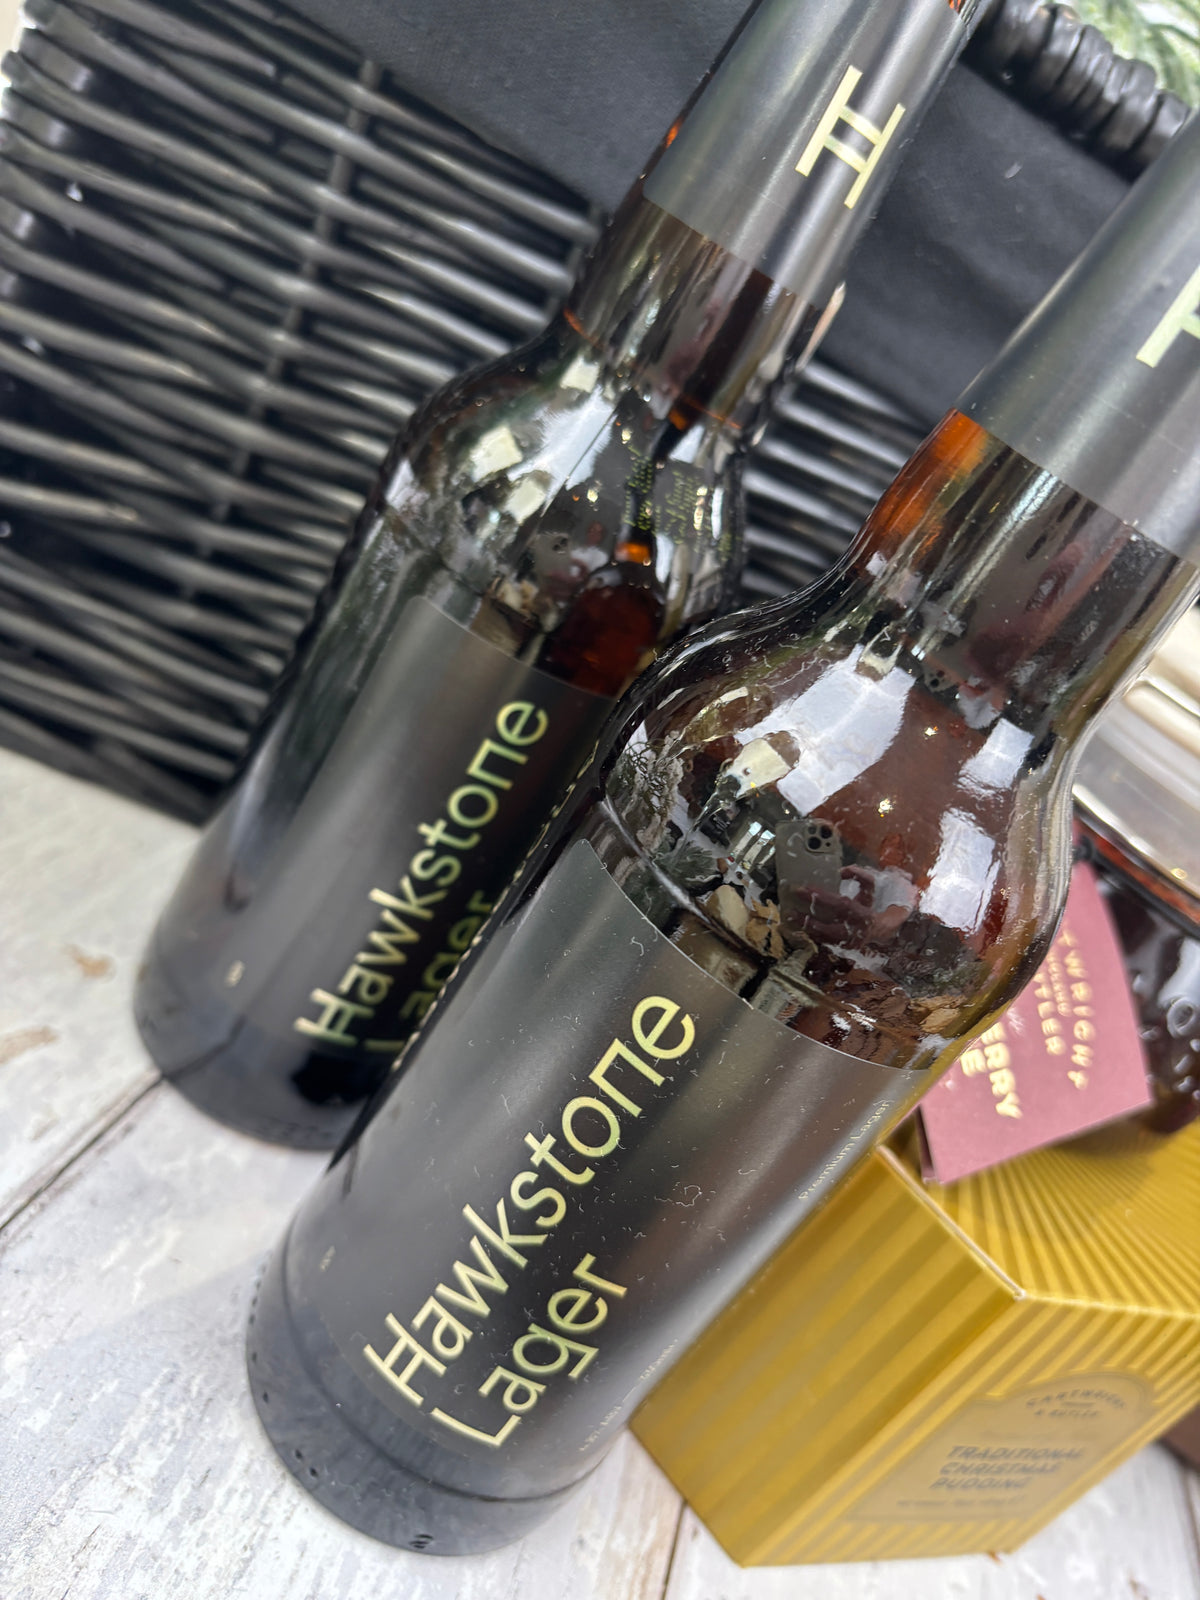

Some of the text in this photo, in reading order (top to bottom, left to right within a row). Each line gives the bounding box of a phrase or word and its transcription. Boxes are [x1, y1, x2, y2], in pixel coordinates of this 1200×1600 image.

[294, 700, 549, 1045] Hawkstone
[798, 1101, 890, 1199] Premium Lager
[363, 995, 695, 1405] Hawkstone
[431, 1254, 627, 1447] Lager
[928, 1476, 1033, 1490] PUDDING
[938, 1461, 1063, 1476] CHRISTMAS
[947, 1445, 1085, 1460] TRADITIONAL
